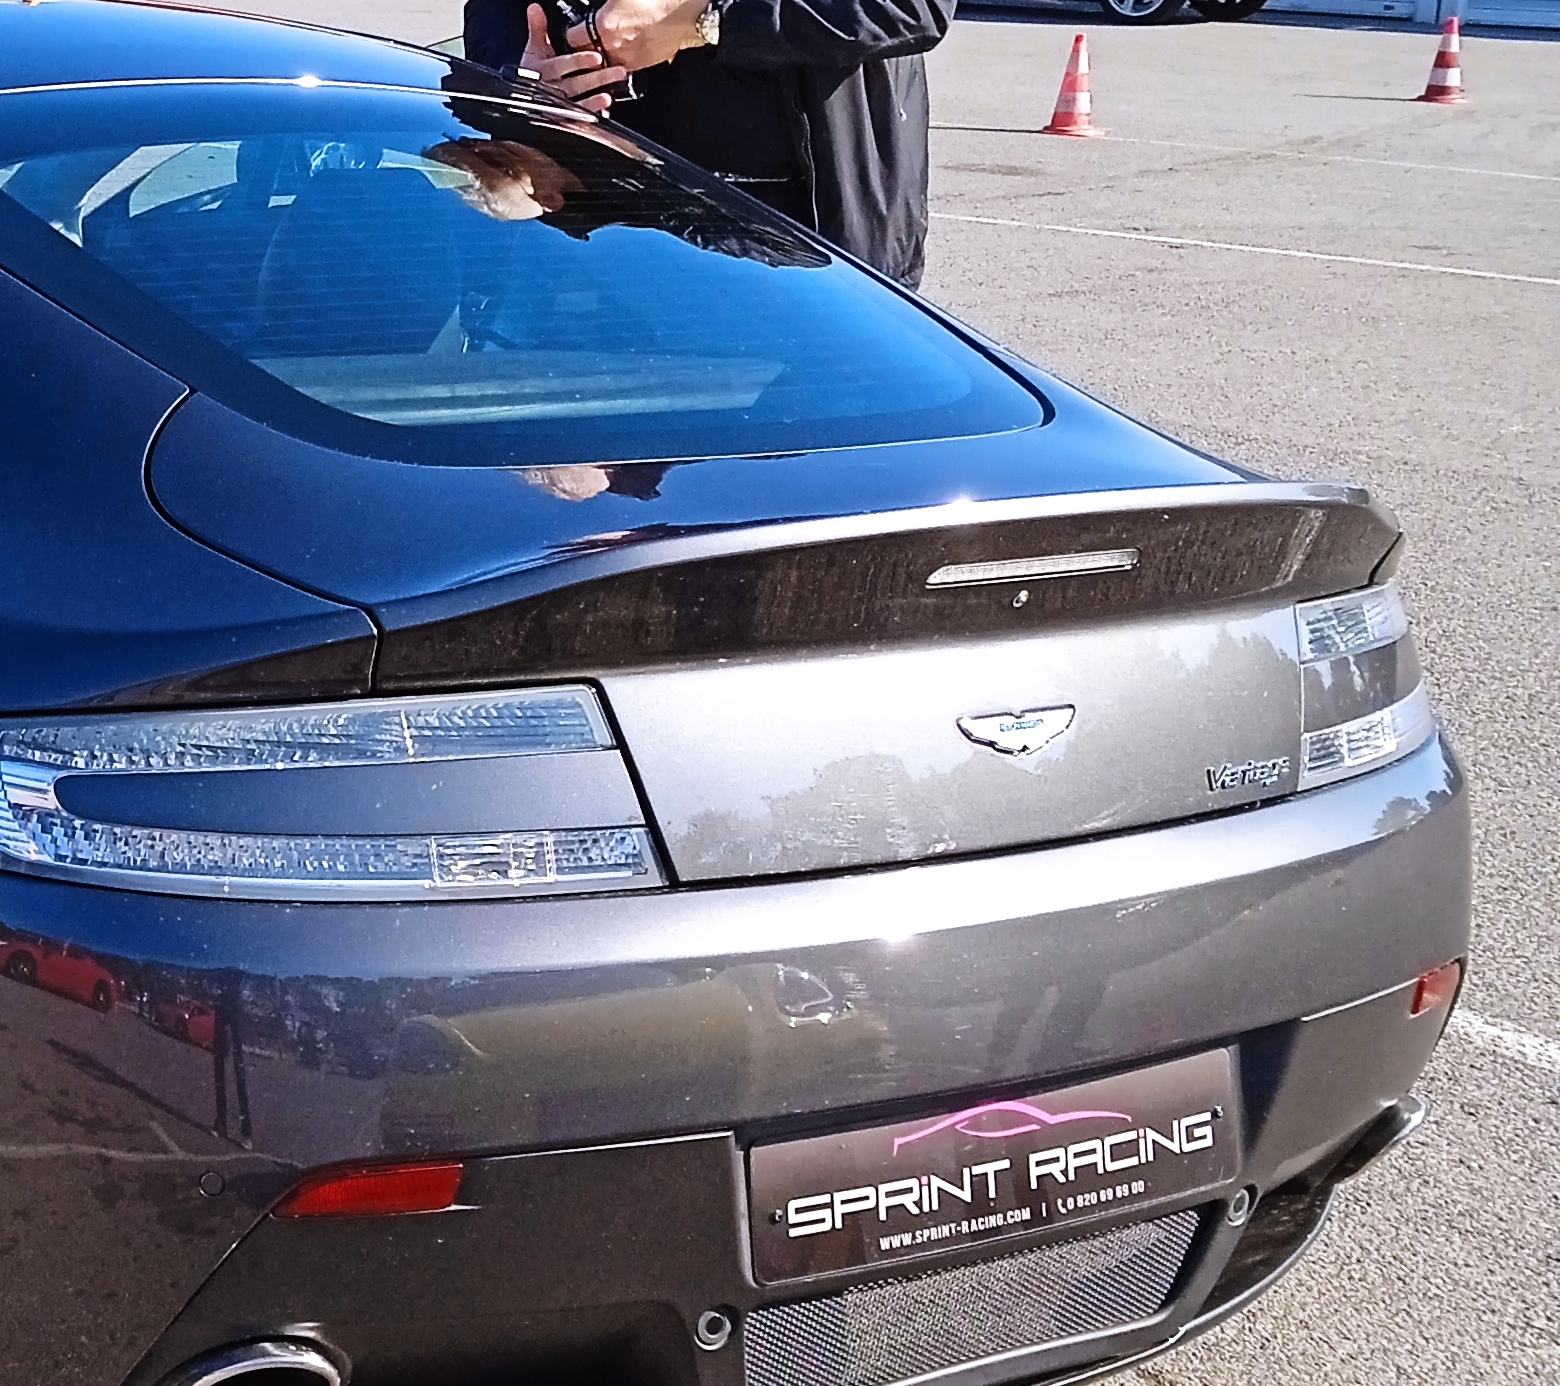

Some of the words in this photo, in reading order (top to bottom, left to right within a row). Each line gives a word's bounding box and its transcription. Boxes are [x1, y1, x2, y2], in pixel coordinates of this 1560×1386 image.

[879, 1207, 1032, 1251] WWW.SPRINT-RACING.COM
[1076, 1192, 1098, 1207] 820
[1100, 1189, 1114, 1202] 69
[1116, 1185, 1130, 1199] 69
[1131, 1180, 1145, 1194] 00
